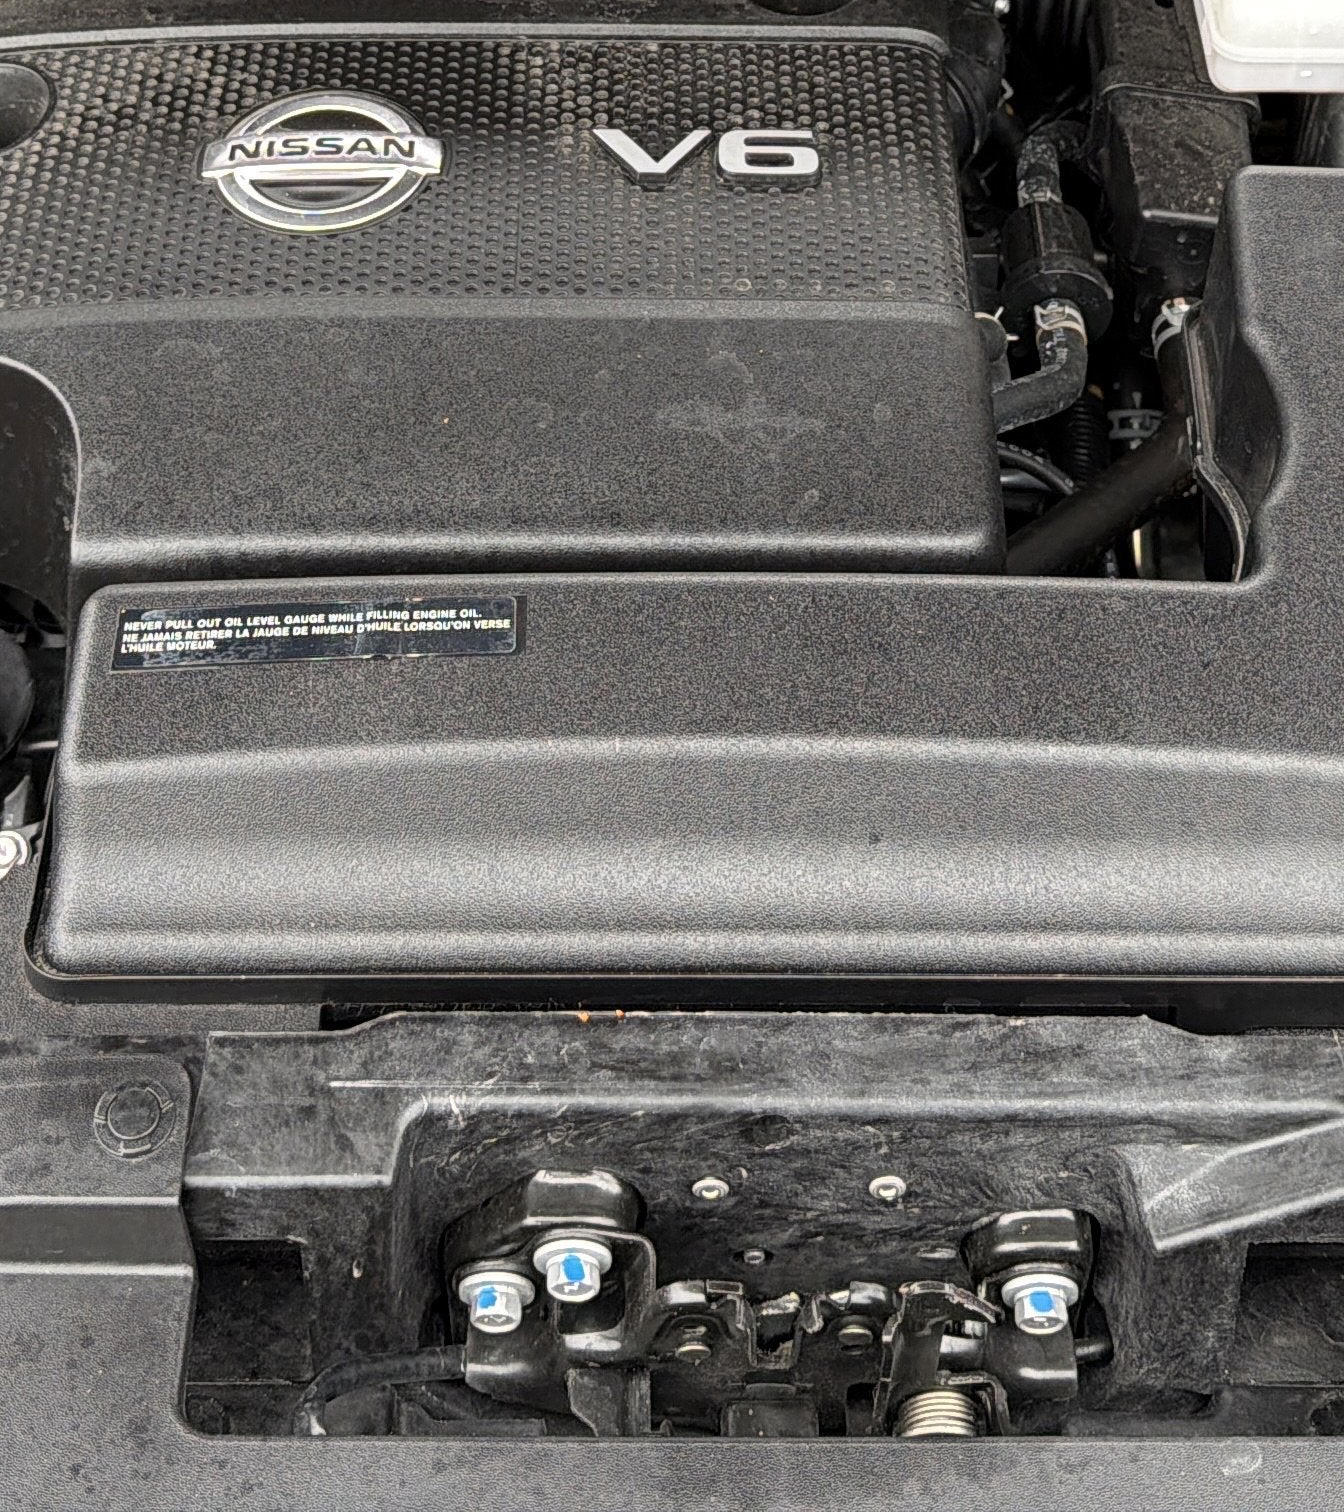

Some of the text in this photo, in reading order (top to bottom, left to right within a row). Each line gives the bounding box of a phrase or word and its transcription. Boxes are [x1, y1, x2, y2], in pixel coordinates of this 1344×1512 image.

[229, 137, 416, 161] NISSAN
[592, 128, 820, 180] V6
[122, 618, 511, 643] NE JAMAIS RETIRER LA JAUGE DE NIVEAU D'HUILE LORSQU'ON VERSE
[123, 608, 482, 631] NEVER PULL OUT OIL LEVEL GAUGE WHILE FILLING ENGINE OIL.
[121, 640, 217, 653] L'HUILE MOTEUR.
